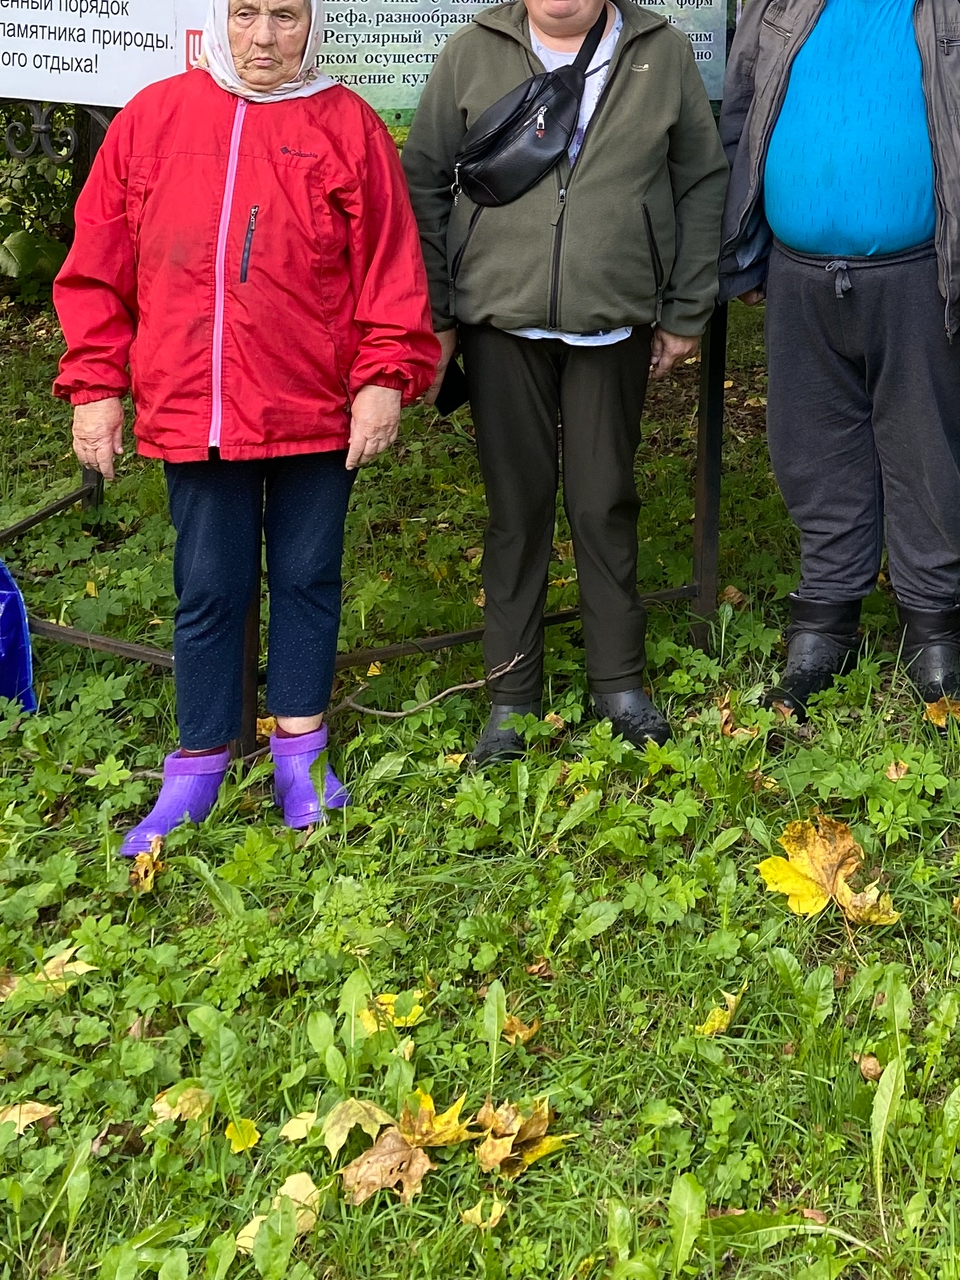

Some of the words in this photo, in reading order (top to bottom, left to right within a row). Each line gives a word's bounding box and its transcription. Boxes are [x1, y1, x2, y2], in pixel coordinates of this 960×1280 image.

[91, 28, 174, 53] природы.
[32, 52, 99, 75] отдыха!
[289, 149, 319, 160] Columbia
